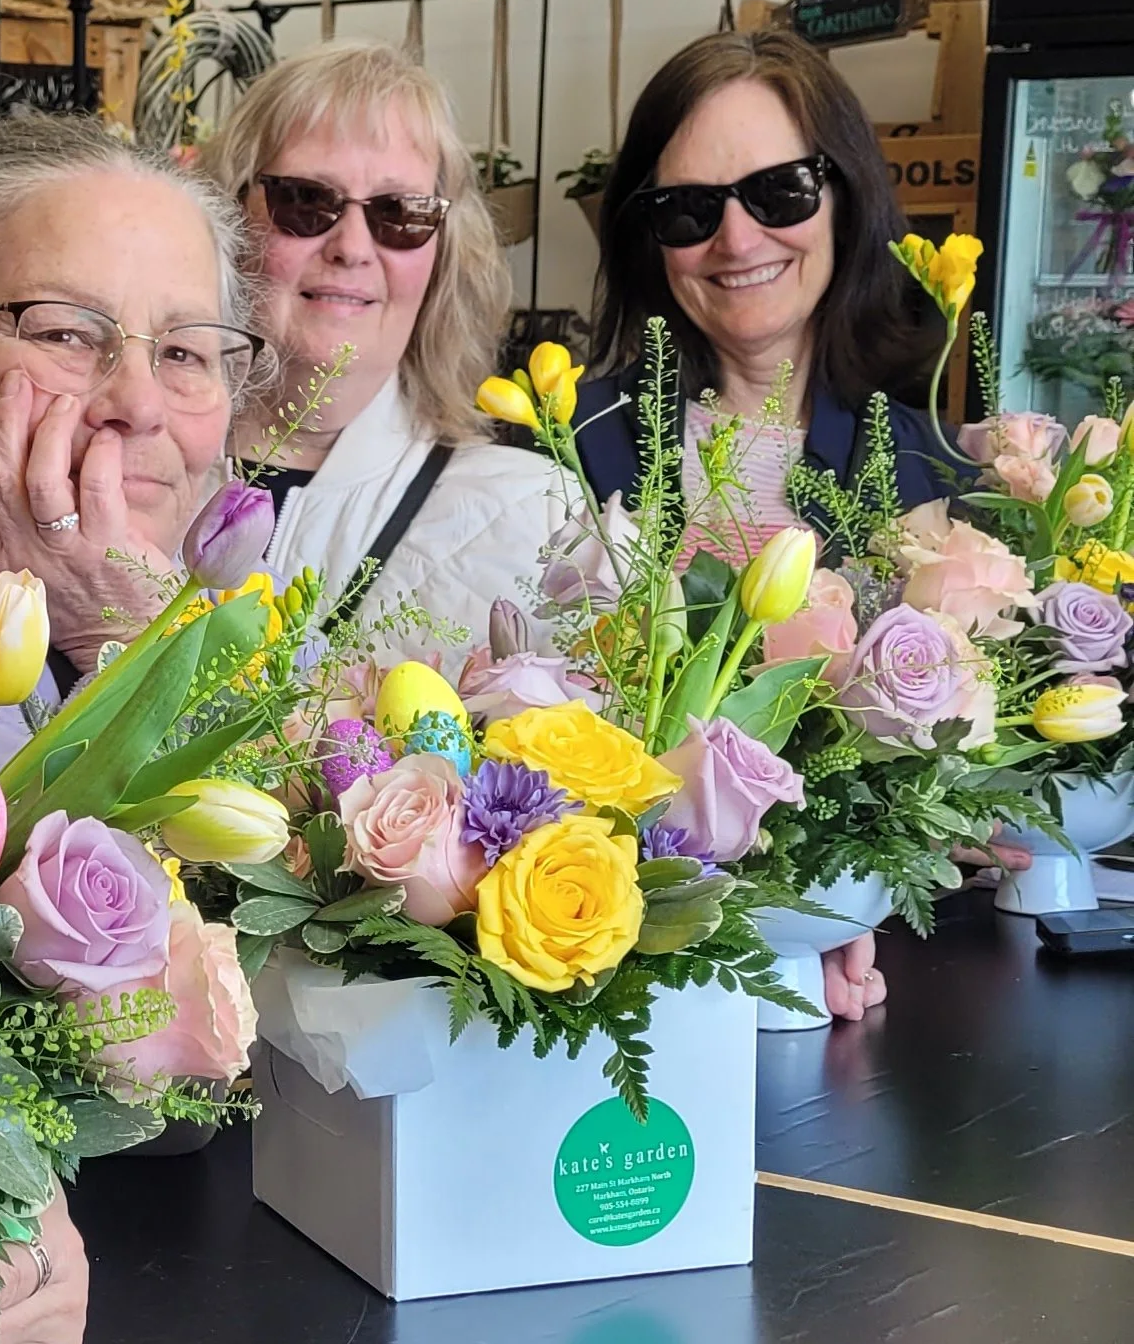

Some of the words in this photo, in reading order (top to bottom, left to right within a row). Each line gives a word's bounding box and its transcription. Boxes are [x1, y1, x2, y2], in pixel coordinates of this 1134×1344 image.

[624, 1142, 688, 1170] garden
[575, 1183, 589, 1193] 227
[590, 1182, 608, 1190] Main
[617, 1175, 650, 1186] Markham
[651, 1171, 672, 1181] North
[628, 1185, 655, 1195] Ontario
